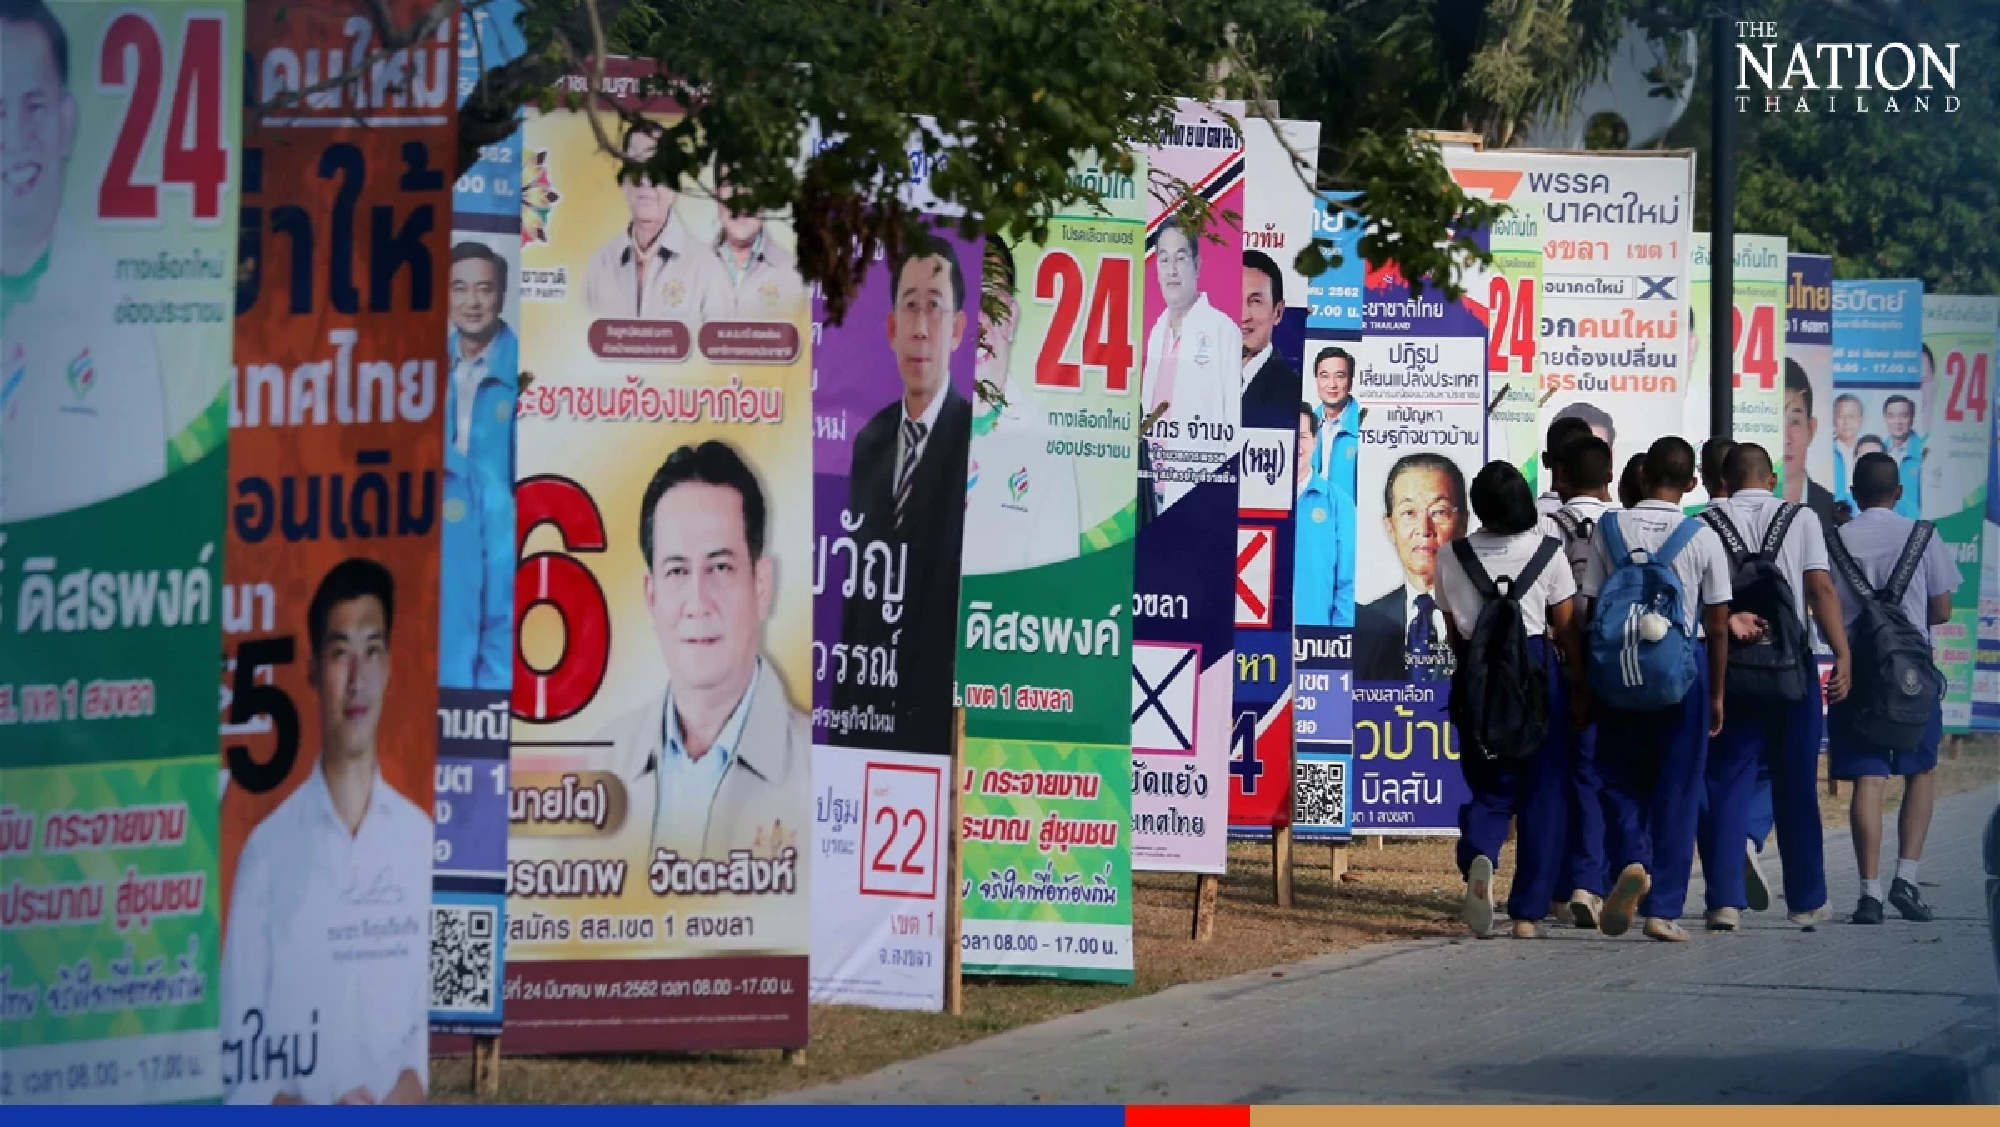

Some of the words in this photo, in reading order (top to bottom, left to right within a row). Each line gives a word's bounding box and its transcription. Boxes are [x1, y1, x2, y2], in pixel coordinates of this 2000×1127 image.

[97, 12, 228, 220] 24
[1528, 172, 1610, 194] พรรค
[1546, 191, 1680, 225] นาคตใหม่
[1626, 242, 1663, 260] เขต
[1669, 241, 1678, 259] 1
[1544, 279, 1624, 295] อนาคตใหม่
[1035, 251, 1134, 390] 24
[1488, 276, 1535, 373] 24
[1389, 342, 1439, 373] ปฏิรูป
[1945, 352, 1988, 423] 24
[813, 410, 847, 441] หม่
[1047, 407, 1131, 433] ทางเลือกใหม่
[1046, 438, 1131, 460] ของประชาชน
[1242, 440, 1285, 485] (หมู)
[234, 450, 436, 543] อนเดิม
[1299, 673, 1329, 692] เขต
[1340, 673, 1349, 692] 1
[965, 684, 997, 709] เขต
[1001, 685, 1011, 709] 1
[1016, 687, 1074, 713] สงขลา
[227, 636, 299, 793] 5
[1229, 711, 1264, 796] 4
[489, 764, 507, 794] 1
[982, 770, 1099, 799] กระจายงาน
[1361, 772, 1444, 805] บิลสัน
[816, 786, 859, 832] ปฐม
[871, 806, 928, 874] 22
[1039, 812, 1119, 853] สู่ชุมชน
[664, 916, 674, 937] 1
[686, 915, 755, 938] สงขลา
[926, 912, 934, 935] 1
[993, 934, 1037, 951] 08.00
[1055, 936, 1098, 954] 17.00
[1102, 939, 1119, 956] น.
[522, 982, 541, 1000] 24
